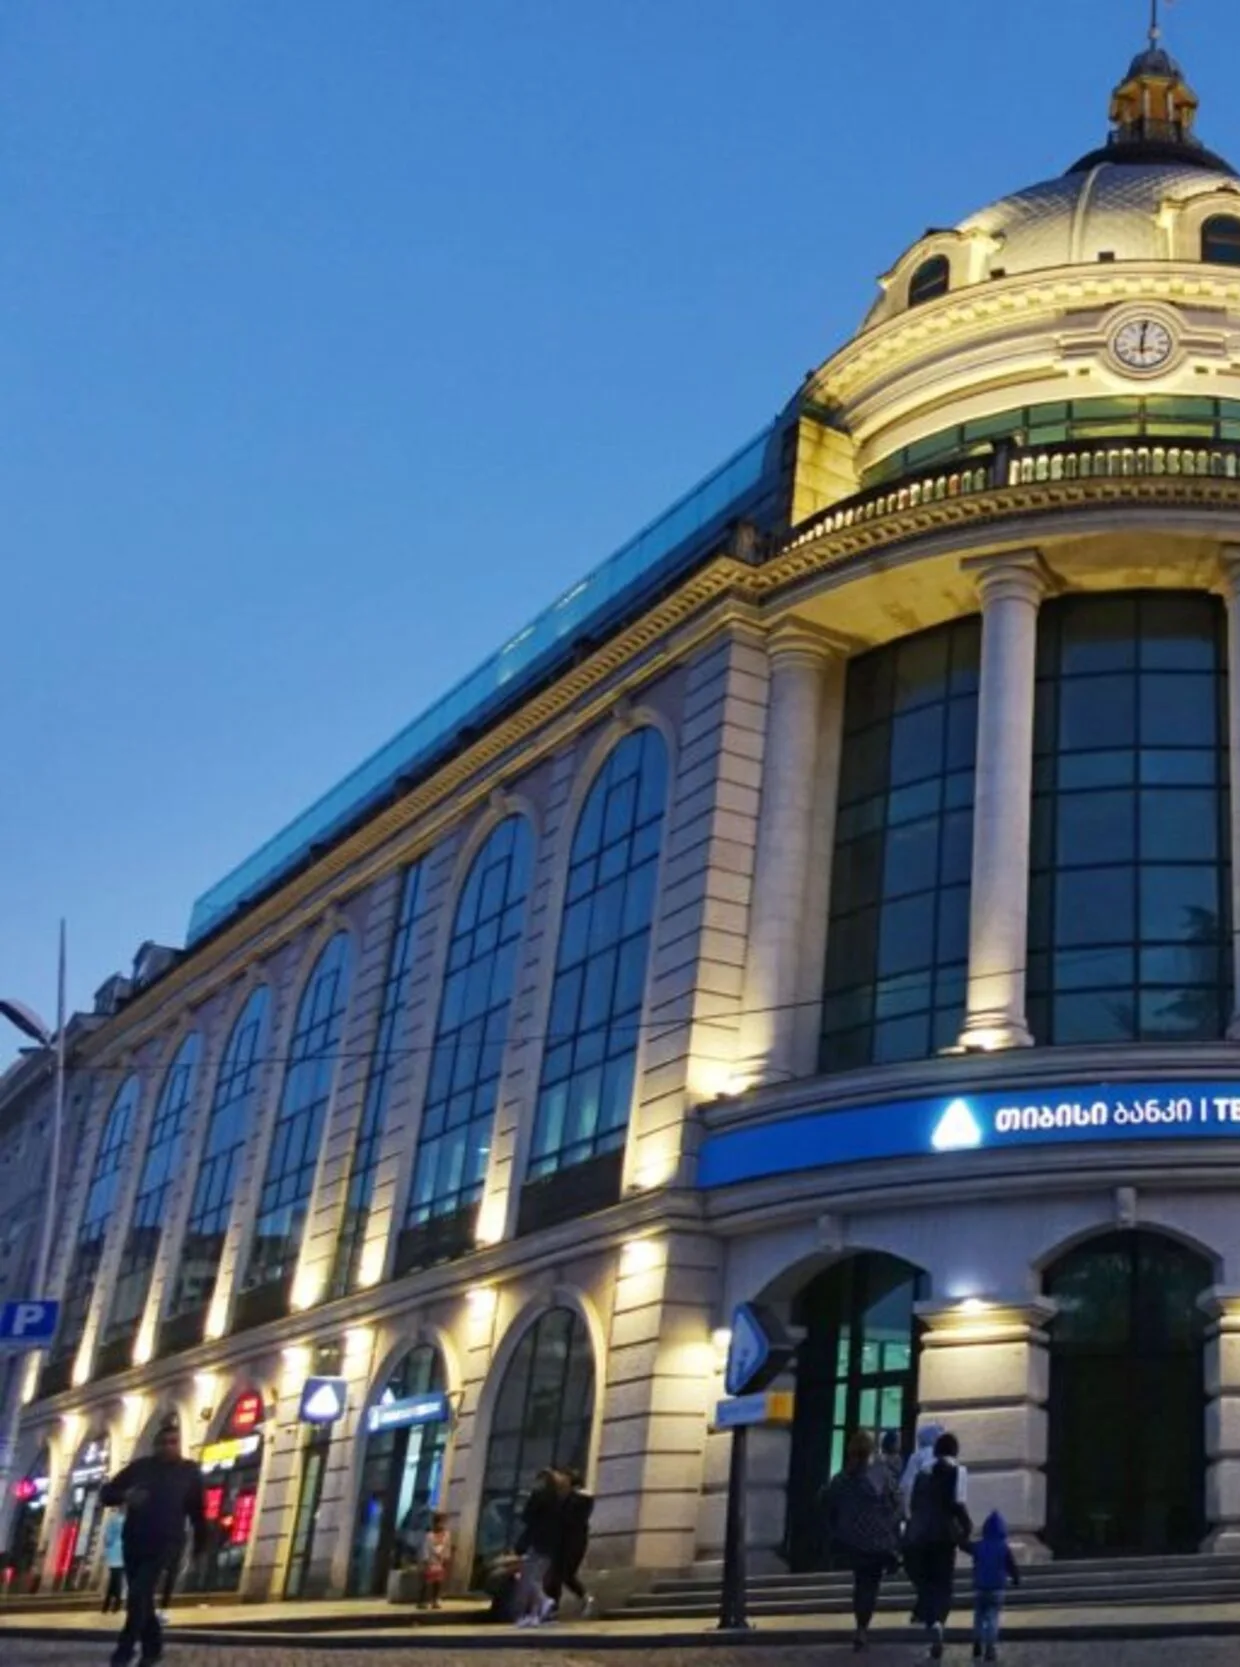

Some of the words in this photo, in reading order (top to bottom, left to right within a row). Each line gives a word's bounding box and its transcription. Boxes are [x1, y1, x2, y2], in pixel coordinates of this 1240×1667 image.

[995, 1103, 1108, 1132] თიბისი
[1113, 1097, 1192, 1125] ბანკი
[12, 1304, 45, 1335] P
